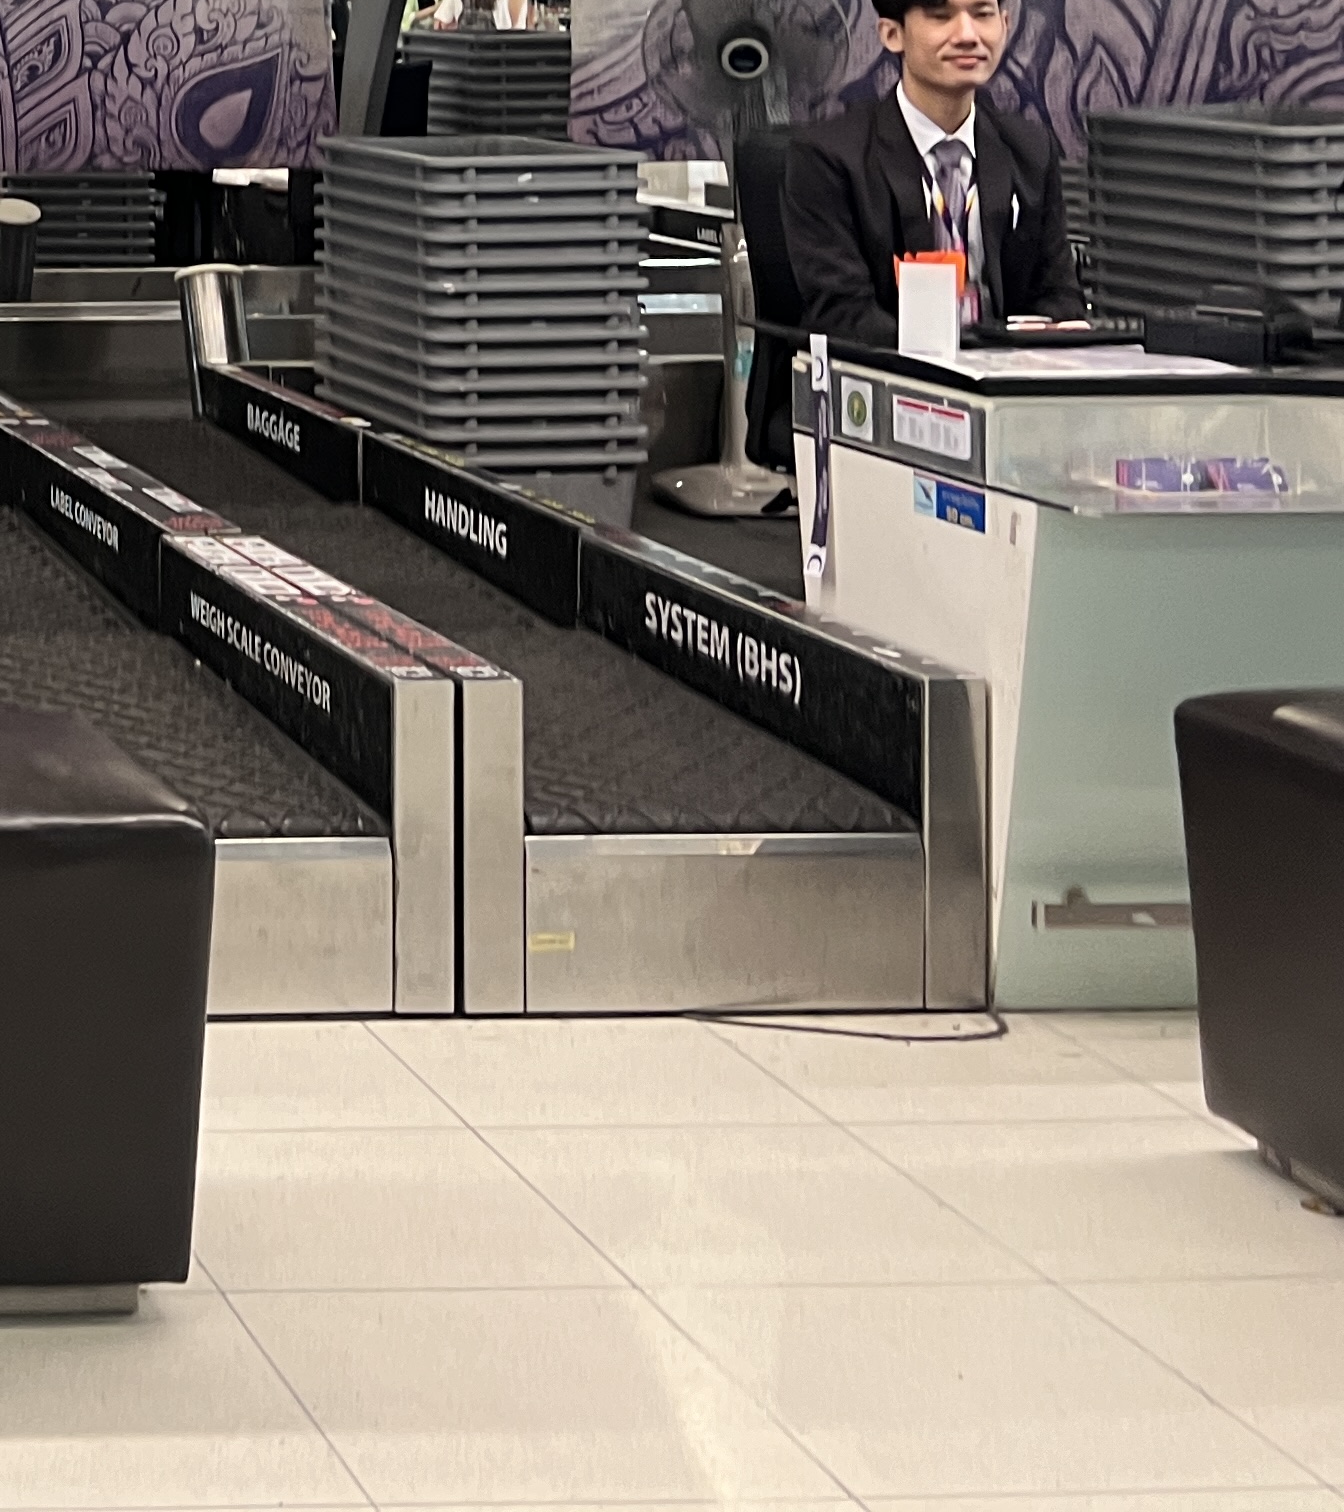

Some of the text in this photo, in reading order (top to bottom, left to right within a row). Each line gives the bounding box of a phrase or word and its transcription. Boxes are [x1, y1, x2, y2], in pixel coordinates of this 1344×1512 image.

[247, 402, 301, 454] BAGGAGE
[50, 483, 119, 553] LABEL CONVEYOR
[424, 486, 507, 559] HANDLING
[190, 589, 225, 639] WEIGH
[226, 616, 262, 665] SCALE
[263, 641, 331, 716] CONVEYOR
[645, 591, 802, 711] SYSTEM (BHS)
